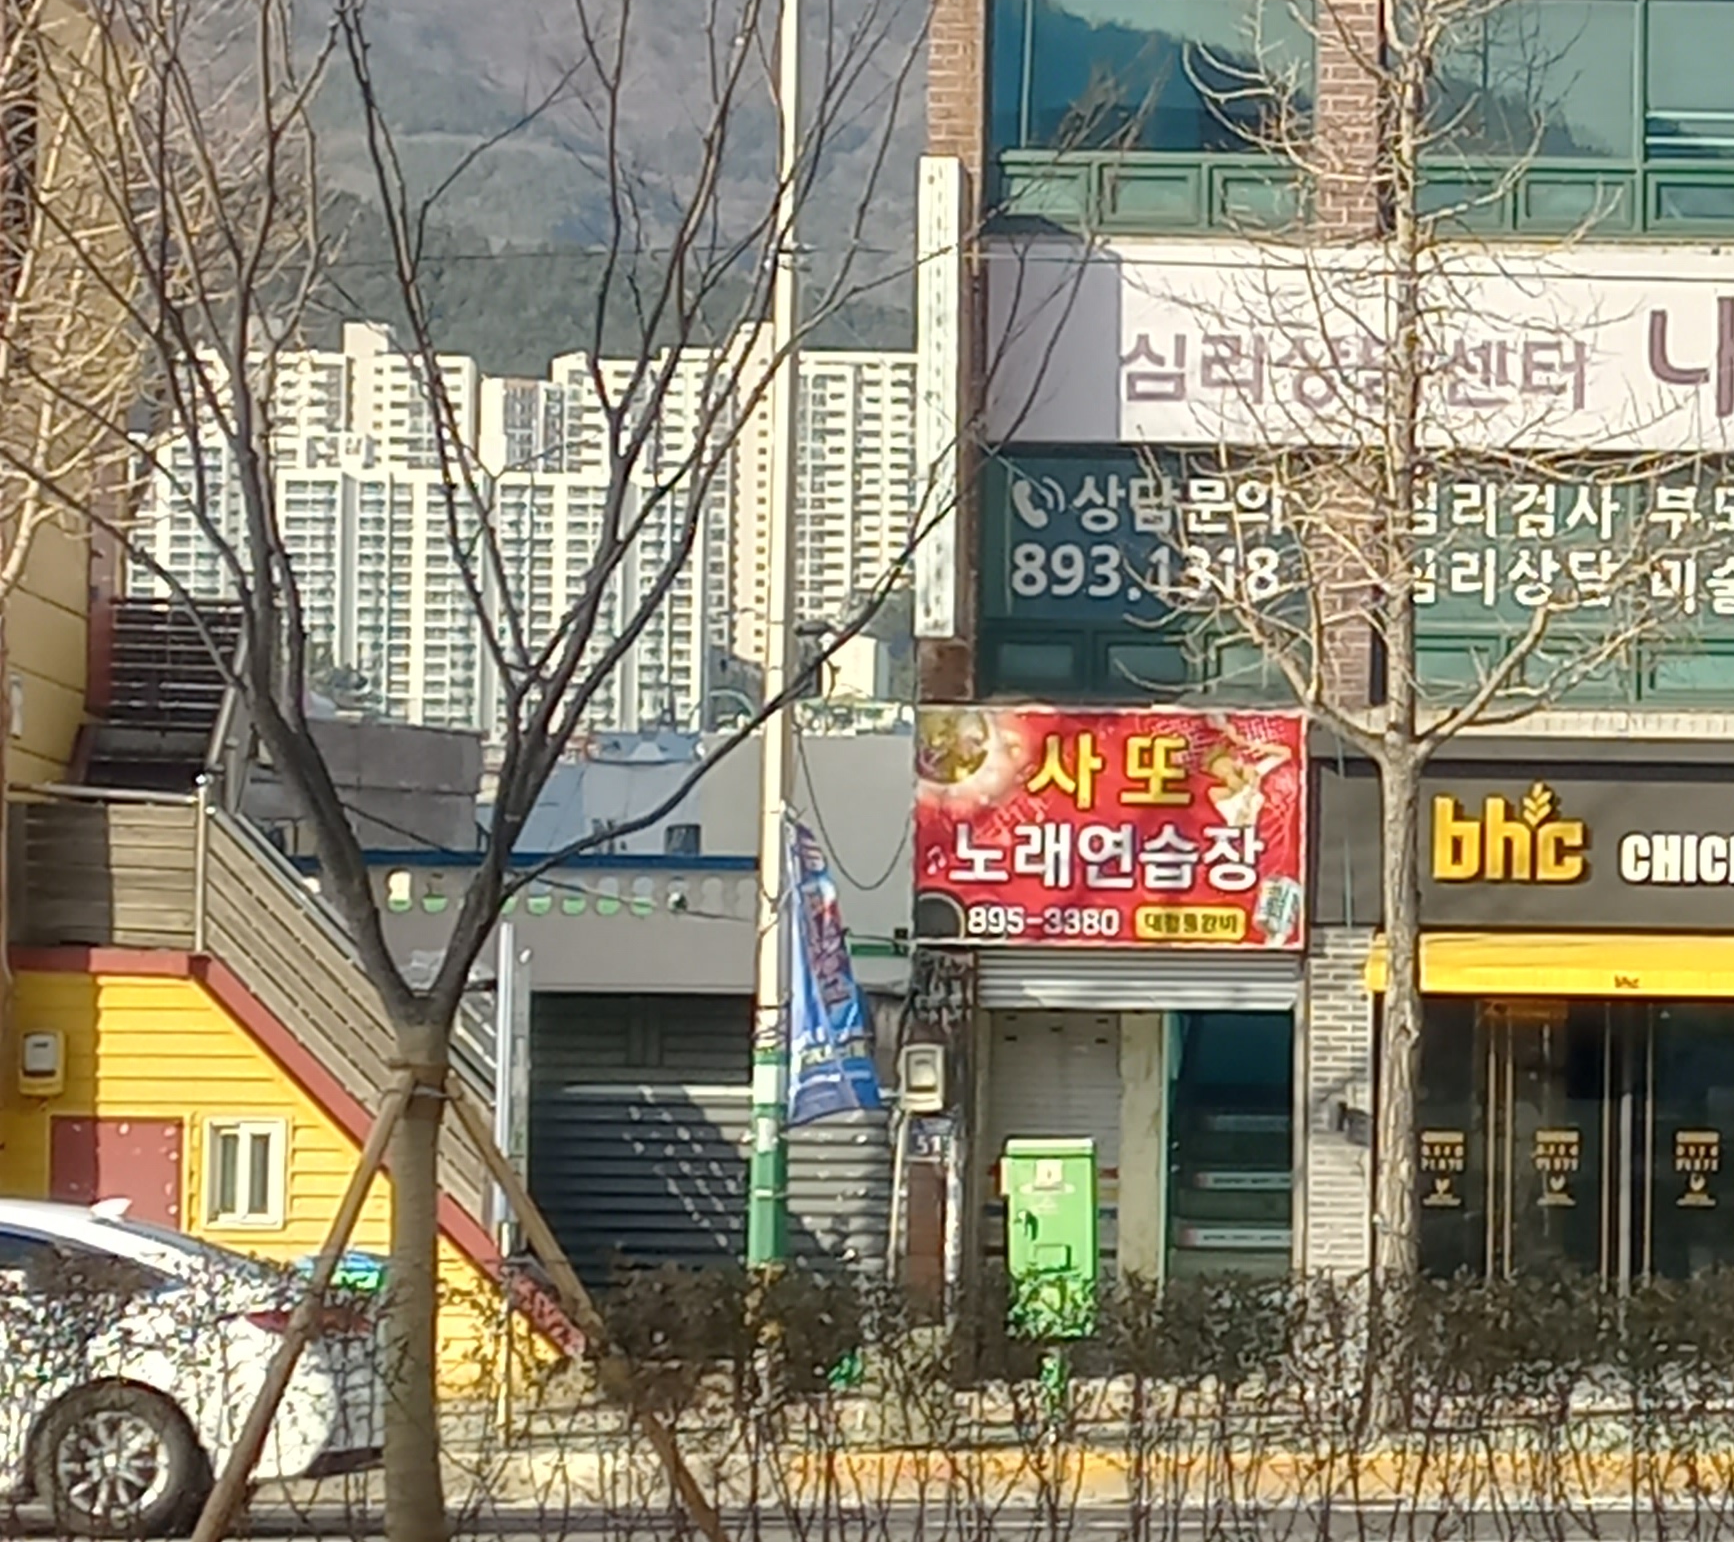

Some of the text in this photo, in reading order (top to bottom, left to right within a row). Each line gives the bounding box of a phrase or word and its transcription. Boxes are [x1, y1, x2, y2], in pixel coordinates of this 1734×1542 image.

[1073, 473, 1283, 536] 상담문의
[1412, 481, 1621, 540] 심리검사
[1011, 542, 1281, 602] 893.1318
[1412, 546, 1620, 607] 심리상담
[1026, 731, 1193, 810] 사또
[948, 823, 1266, 891] 노래연습장
[1431, 789, 1587, 884] bhc
[967, 906, 1120, 937] 895-3380
